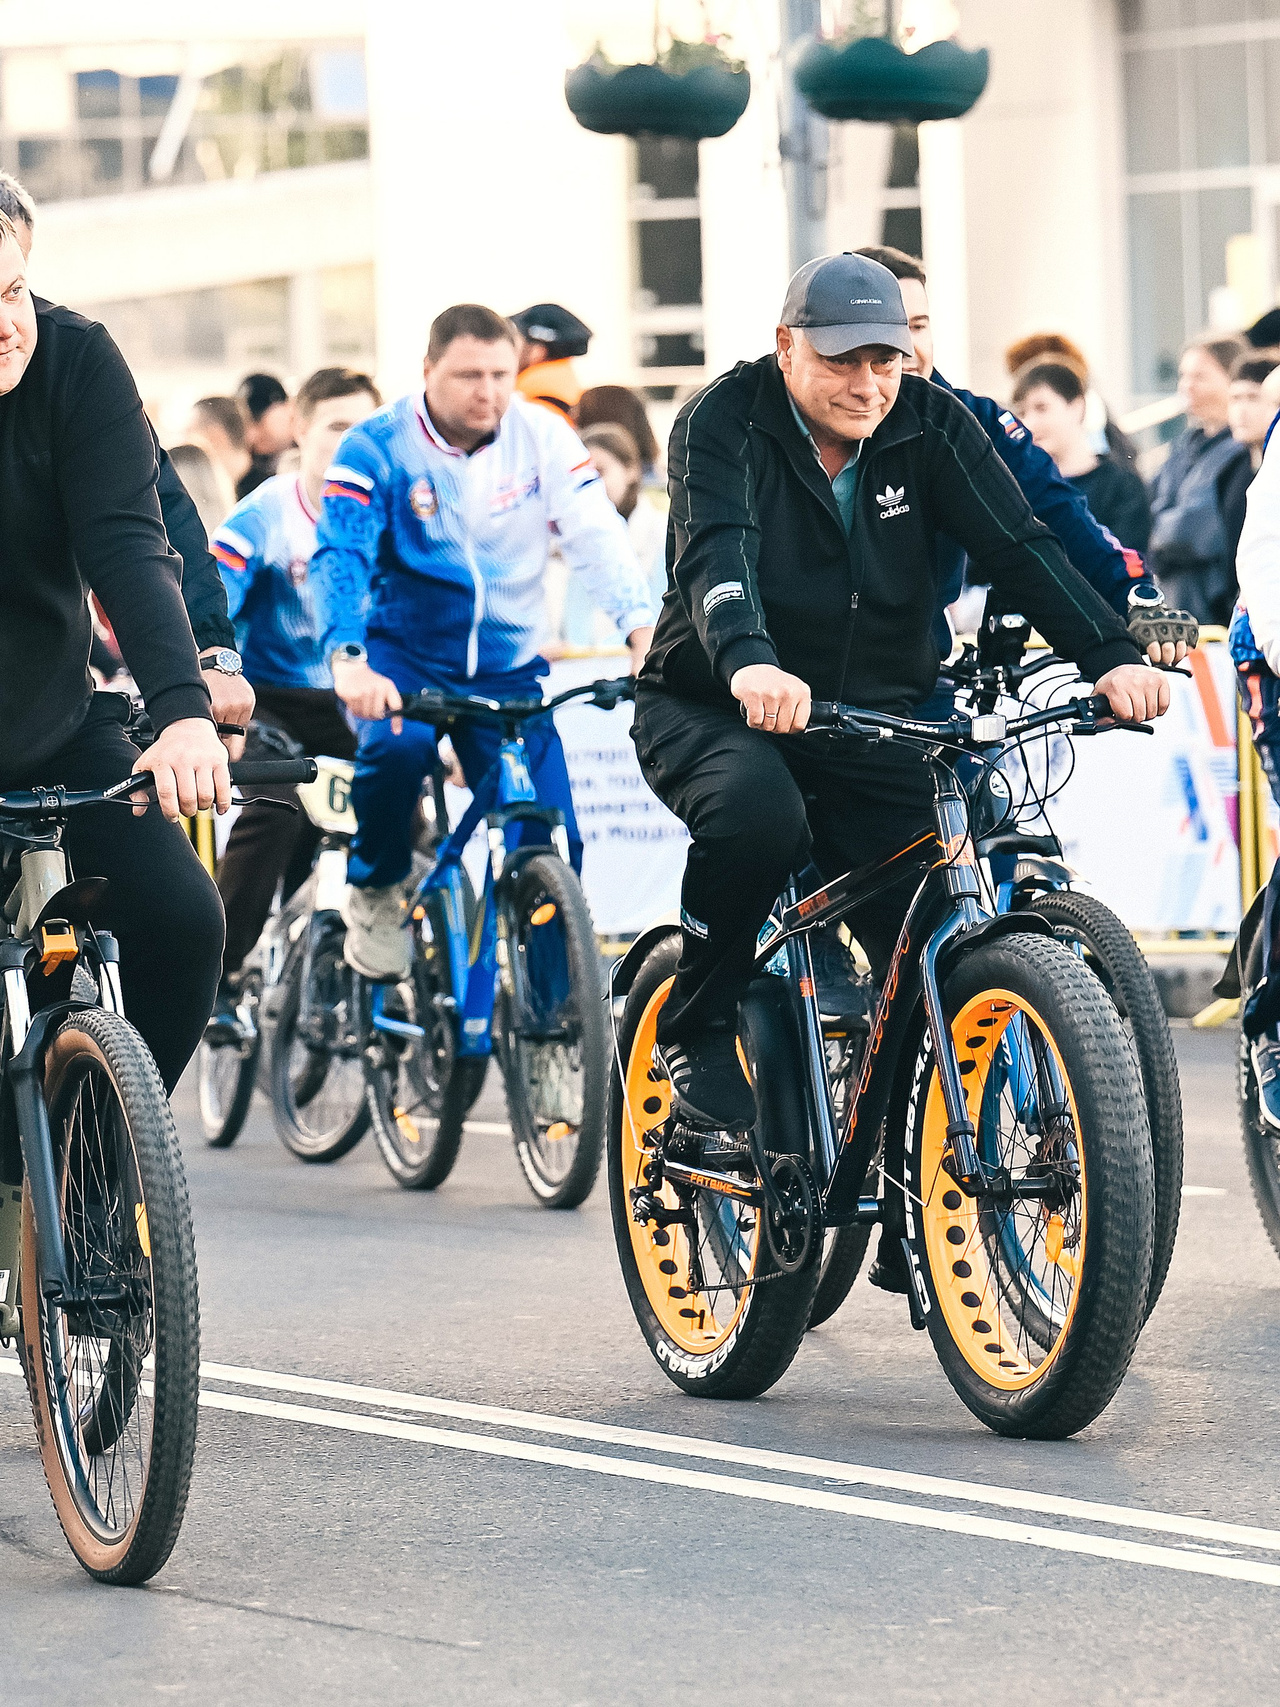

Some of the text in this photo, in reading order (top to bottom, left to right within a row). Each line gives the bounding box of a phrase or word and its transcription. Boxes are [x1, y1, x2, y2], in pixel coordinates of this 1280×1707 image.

[880, 504, 910, 519] adidas
[103, 777, 132, 798] HORST
[690, 1172, 734, 1194] FATBIKE
[909, 1249, 932, 1315] CST
[41, 1313, 61, 1412] HORST
